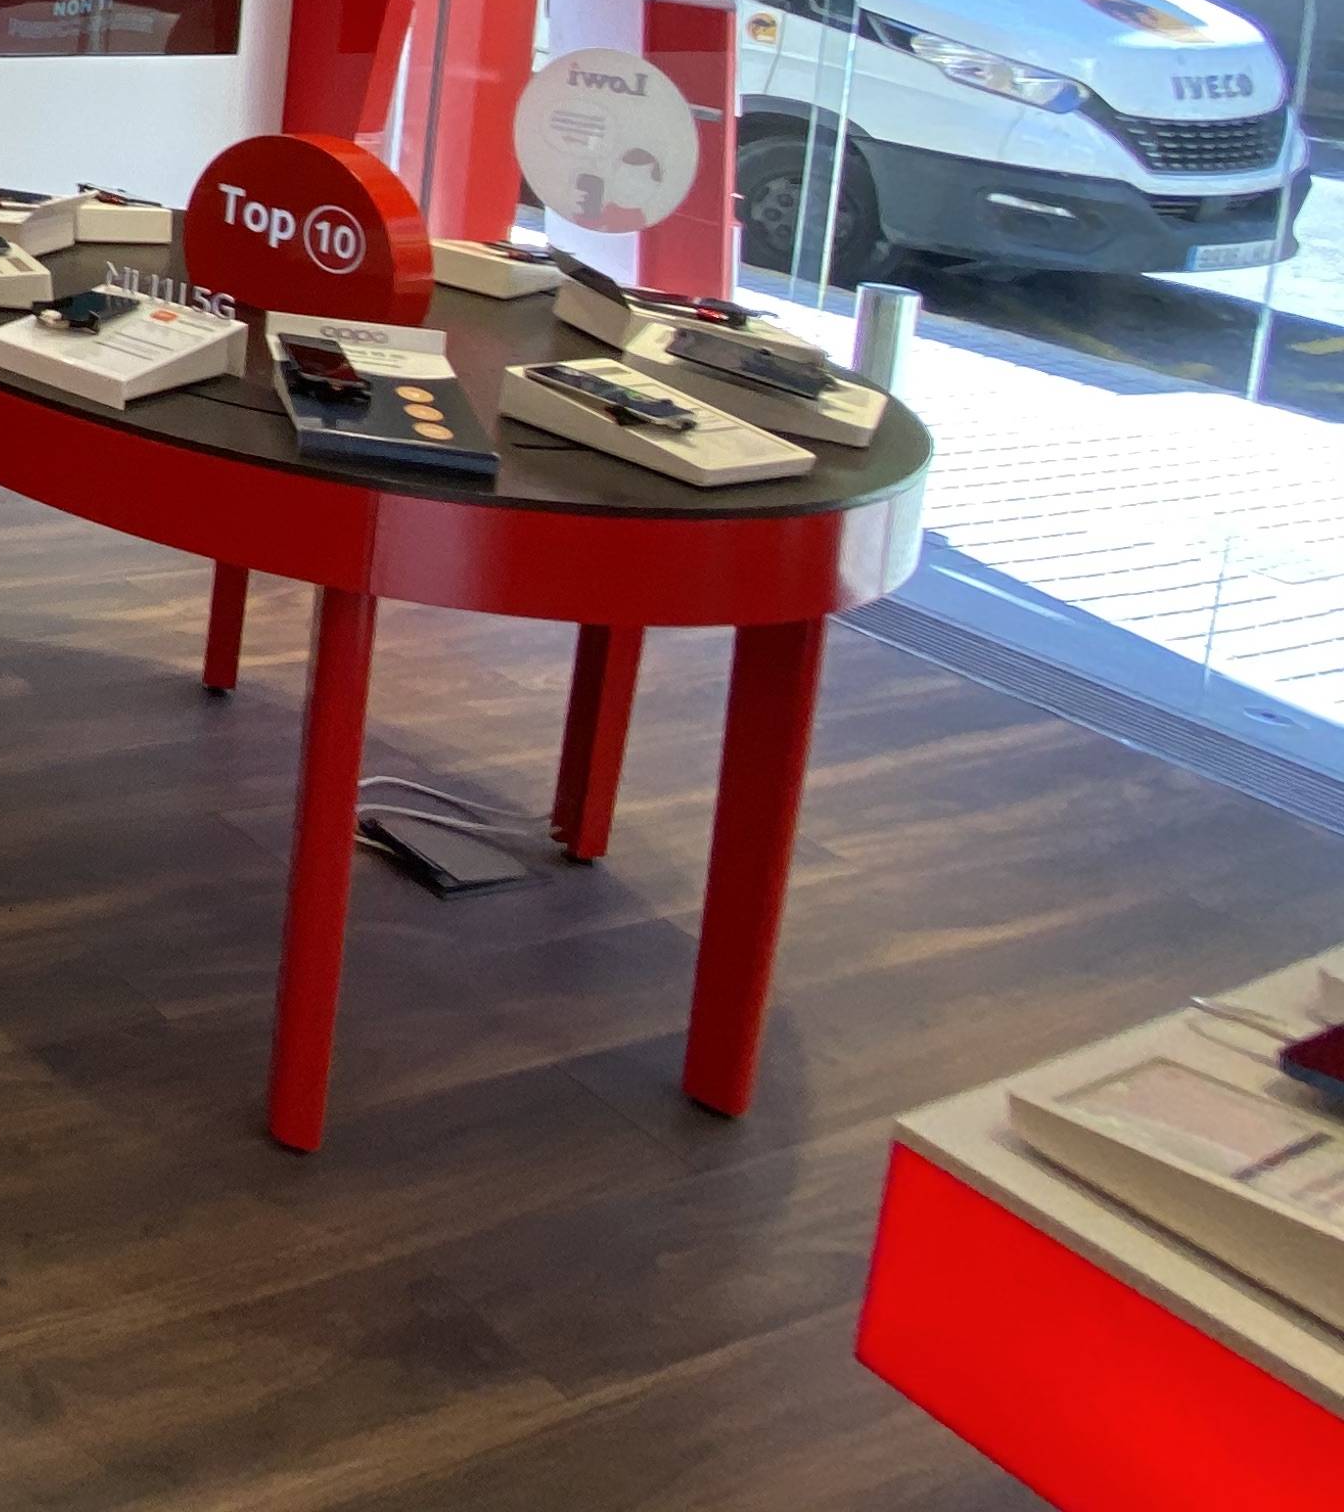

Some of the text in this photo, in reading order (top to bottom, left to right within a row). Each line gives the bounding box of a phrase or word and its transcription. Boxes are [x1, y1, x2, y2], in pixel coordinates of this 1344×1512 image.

[1171, 73, 1255, 101] IVECO
[217, 182, 357, 260] Top 10
[192, 284, 237, 321] 5G
